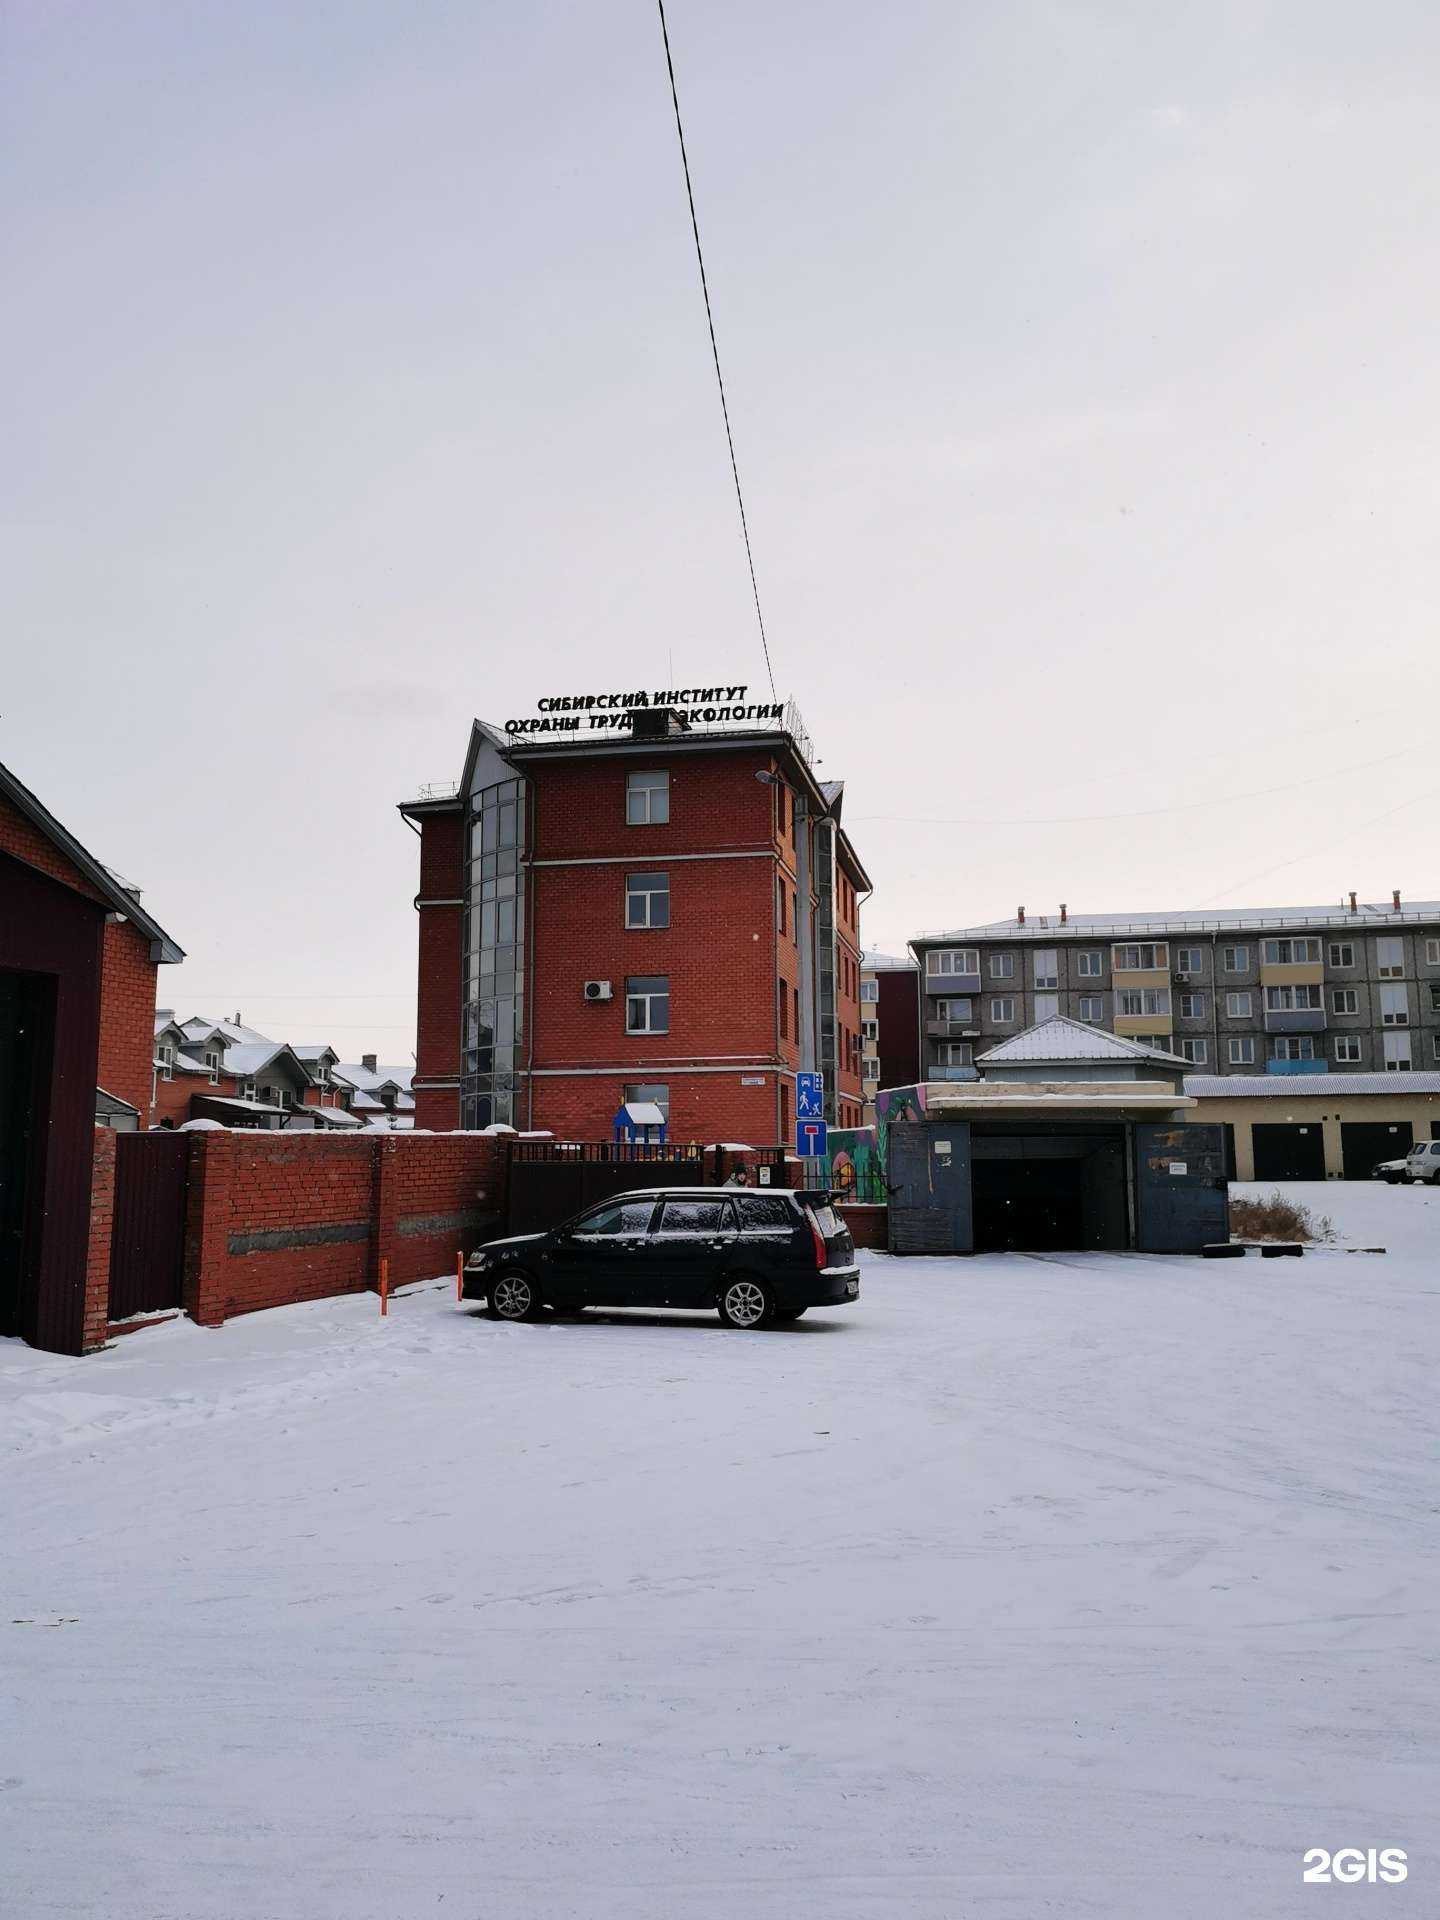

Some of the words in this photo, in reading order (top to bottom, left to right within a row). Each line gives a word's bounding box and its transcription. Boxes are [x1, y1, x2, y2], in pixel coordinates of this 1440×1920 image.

[538, 691, 649, 711] СИБИРСКИЙ
[654, 686, 747, 705] ИНСТИТУТ
[505, 717, 579, 734] ОХРАНЫ
[589, 713, 633, 730] ТРУД
